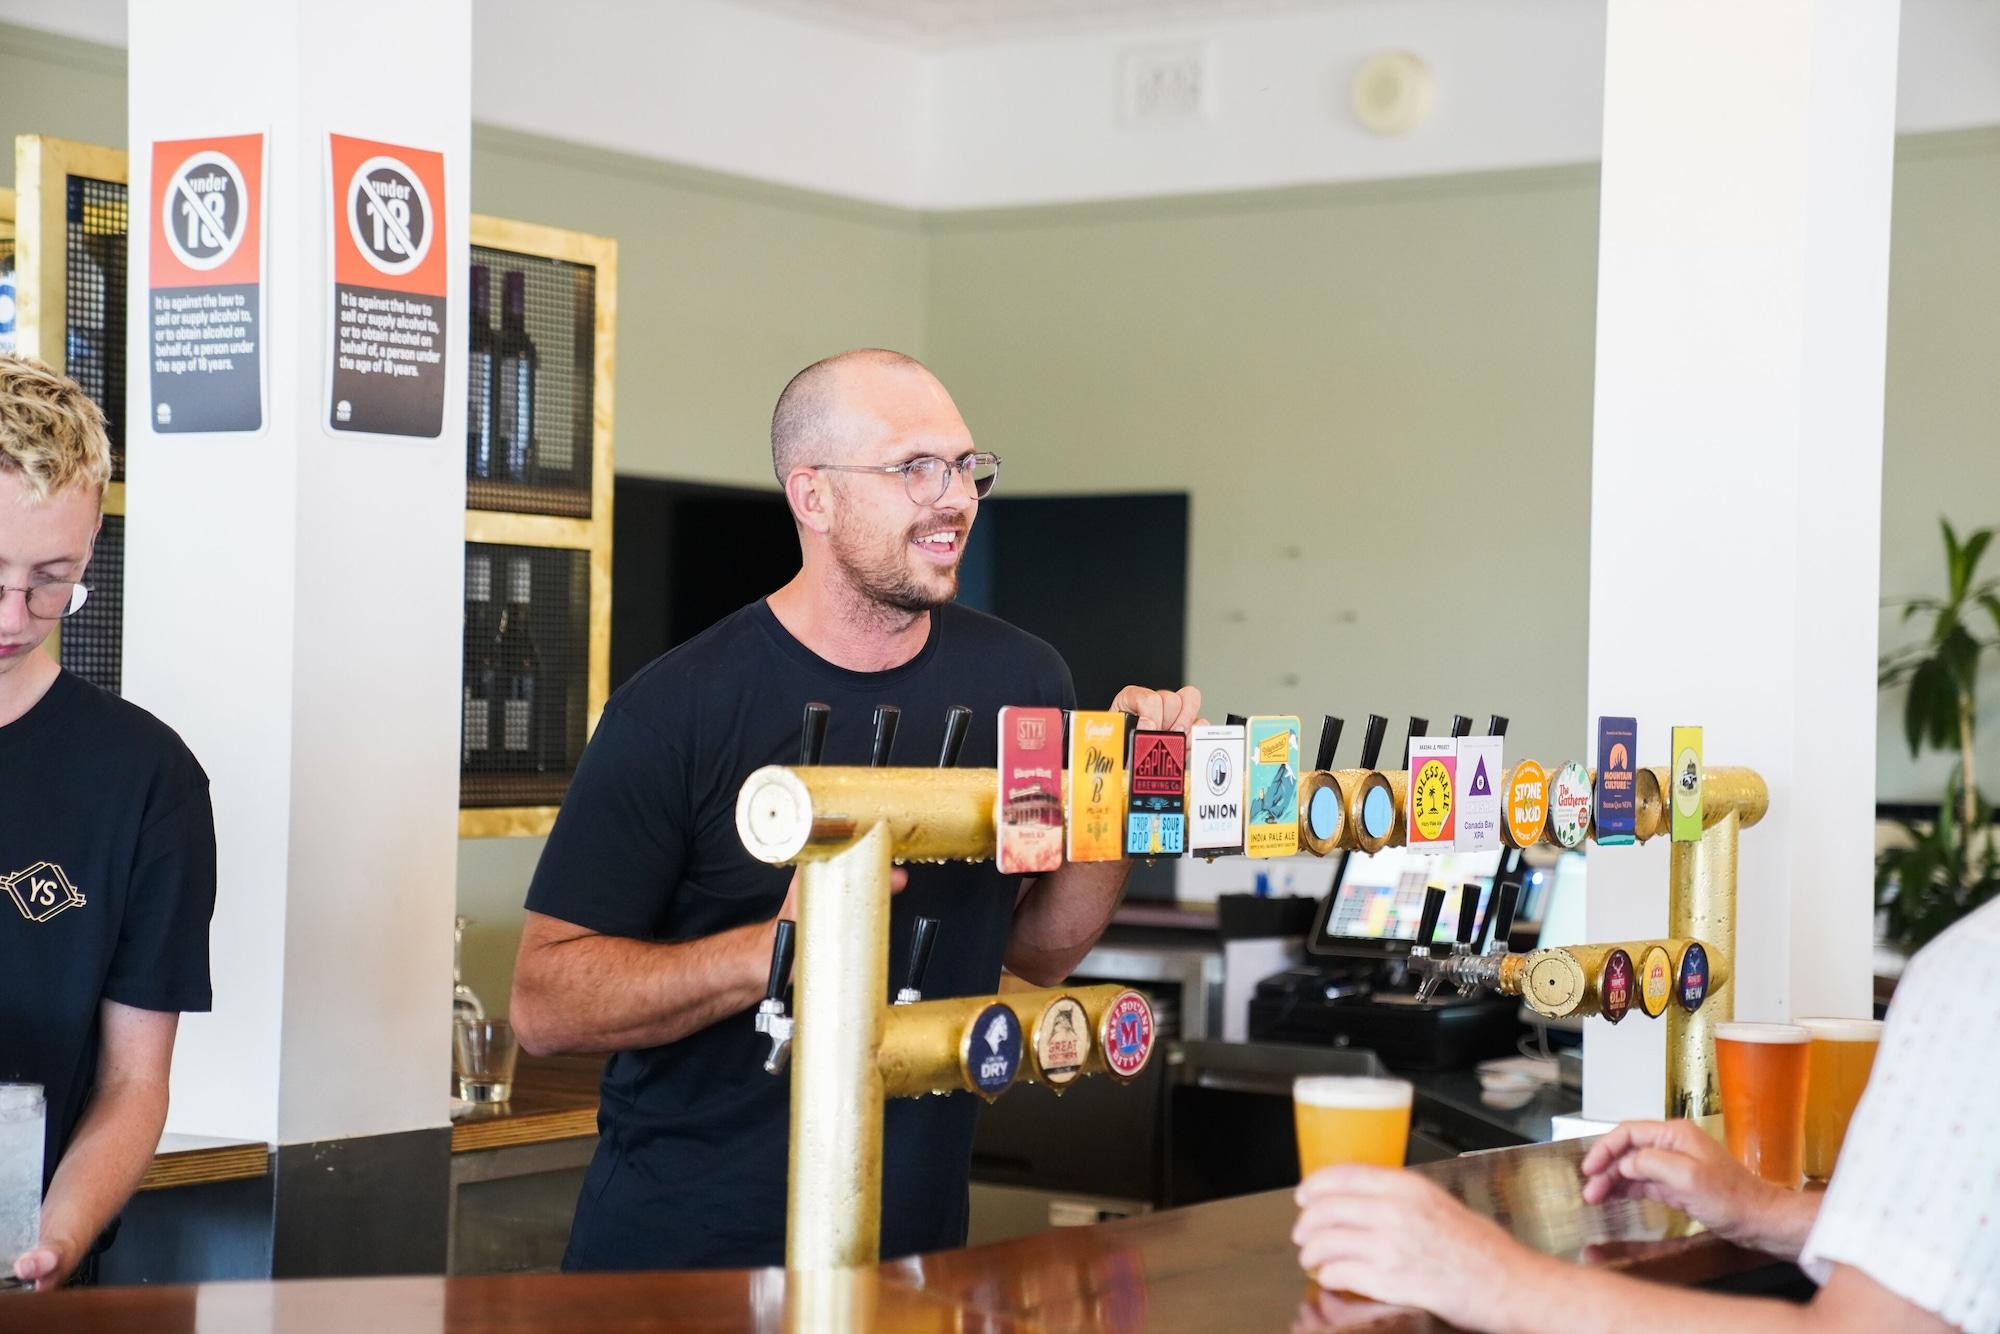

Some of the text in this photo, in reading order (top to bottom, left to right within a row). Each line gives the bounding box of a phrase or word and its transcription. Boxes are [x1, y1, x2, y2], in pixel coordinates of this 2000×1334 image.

[182, 192, 226, 249] 18
[366, 198, 411, 255] 18
[155, 293, 245, 312] It is against the law to
[341, 292, 432, 317] It is against the law to
[155, 308, 252, 326] sell or supply alcohol to,
[341, 309, 440, 335] sell or supply alcohol to,
[156, 325, 245, 341] or to obtain alcohol on
[341, 326, 432, 347] or to obtain alcohol on
[155, 340, 254, 358] behalf of, a person under
[340, 339, 441, 364] behalf of, a person under
[156, 359, 170, 372] the
[171, 361, 186, 375] age
[187, 357, 196, 371] of
[208, 359, 234, 373] years.
[340, 355, 354, 370] the
[355, 360, 372, 374] age
[372, 359, 382, 372] of
[394, 364, 419, 378] years.
[1085, 746, 1115, 774] Plan
[1603, 771, 1632, 780] MOUNTAIN
[1091, 777, 1104, 804] B
[1514, 782, 1542, 802] STONE
[1559, 785, 1569, 796] The
[1604, 780, 1627, 790] CULTURE
[1558, 794, 1588, 807] Gatherer
[1199, 804, 1237, 819] UNION
[1515, 805, 1541, 824] WOOD
[1162, 817, 1180, 831] SOUR
[1464, 820, 1494, 830] Canada Bay
[1131, 832, 1149, 850] POP
[1162, 832, 1180, 850] ALE
[1268, 832, 1282, 841] PALE
[1285, 831, 1295, 841] ALE
[1473, 831, 1484, 840] XPA
[29, 877, 58, 906] YS
[1610, 989, 1626, 1004] OLD
[1685, 986, 1703, 1000] NEW
[1120, 1020, 1139, 1048] M
[1048, 1039, 1077, 1053] GREAT
[981, 1061, 1008, 1078] DRY
